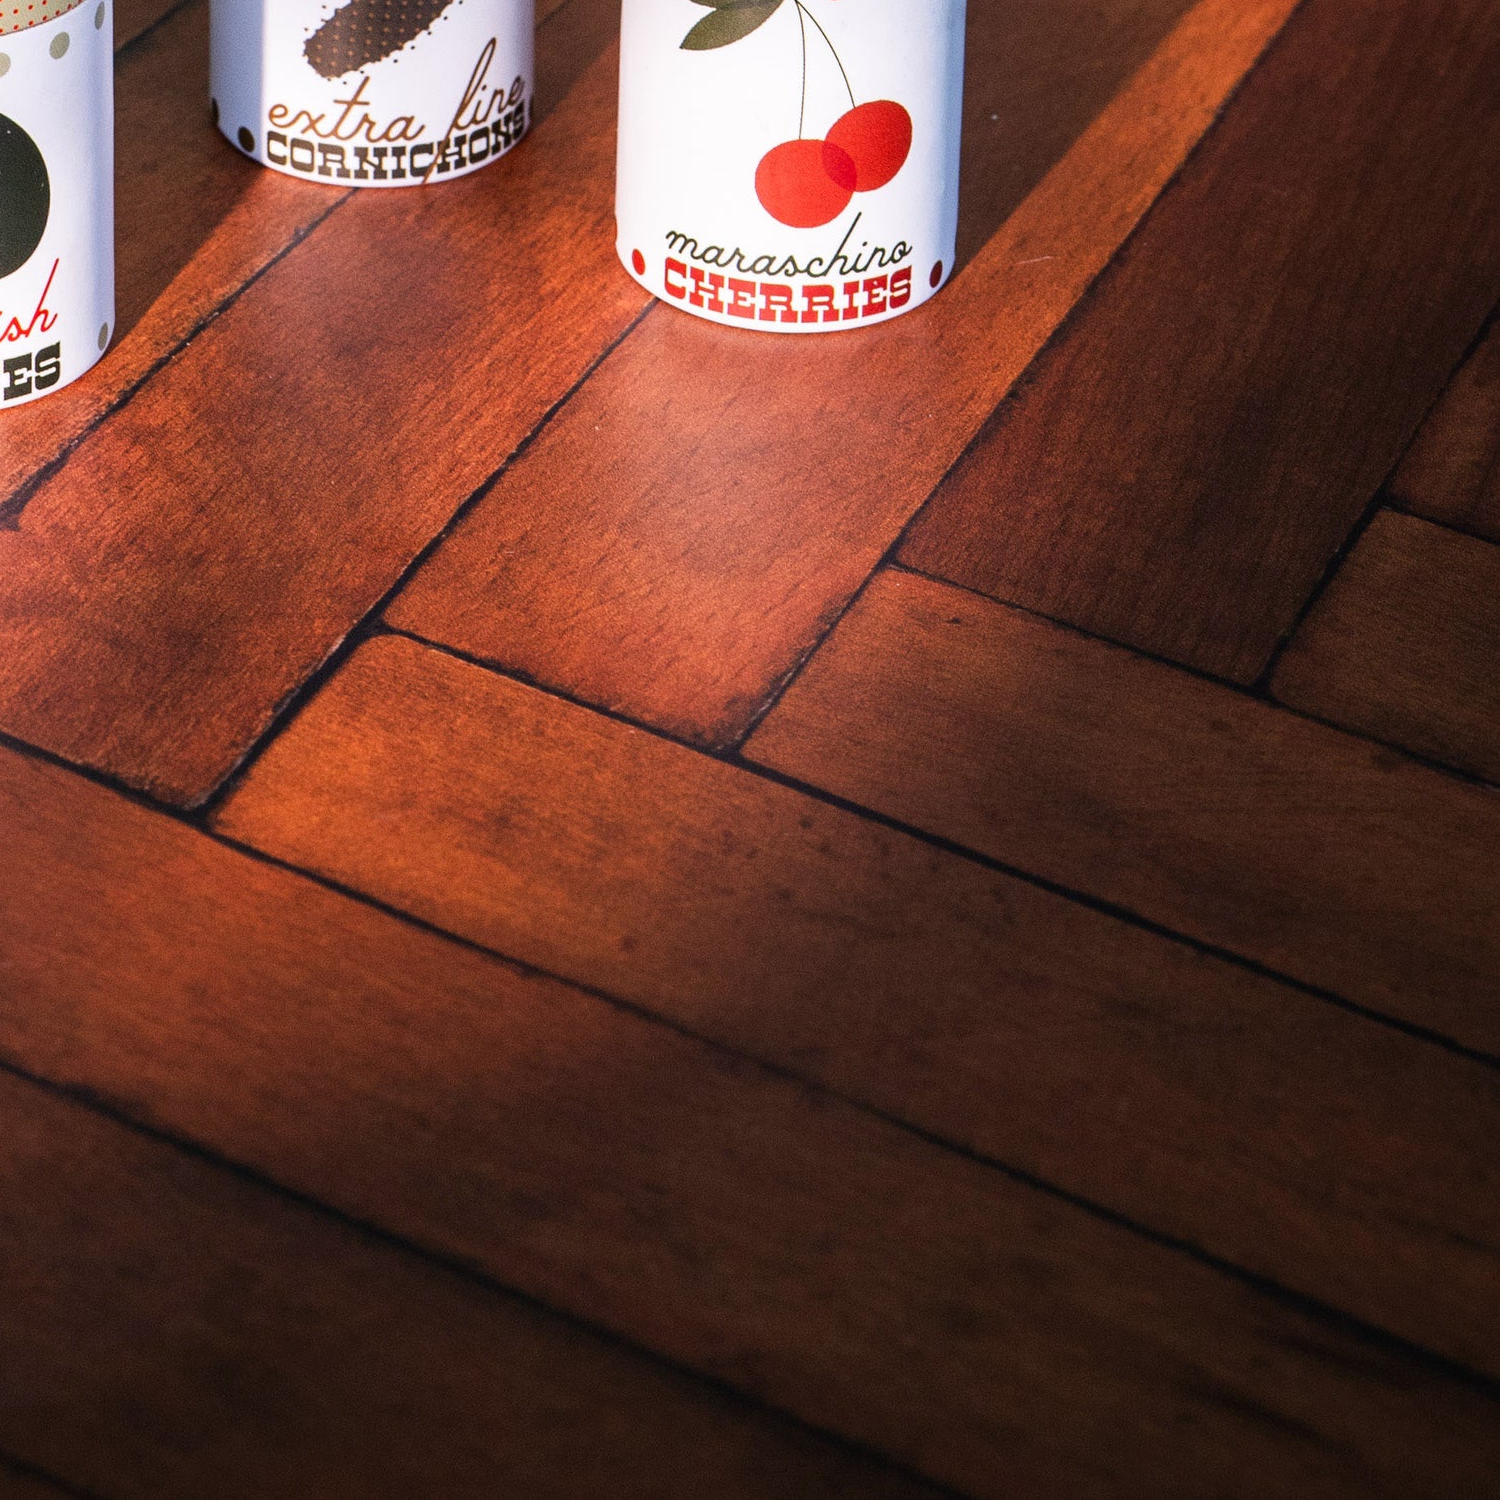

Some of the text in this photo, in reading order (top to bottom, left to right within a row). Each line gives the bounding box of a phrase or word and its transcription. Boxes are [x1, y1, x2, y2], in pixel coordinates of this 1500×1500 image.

[266, 98, 526, 180] CORNICHONS
[268, 37, 526, 184] extra fine
[664, 211, 913, 278] maraschino
[664, 258, 913, 324] CHERRIES
